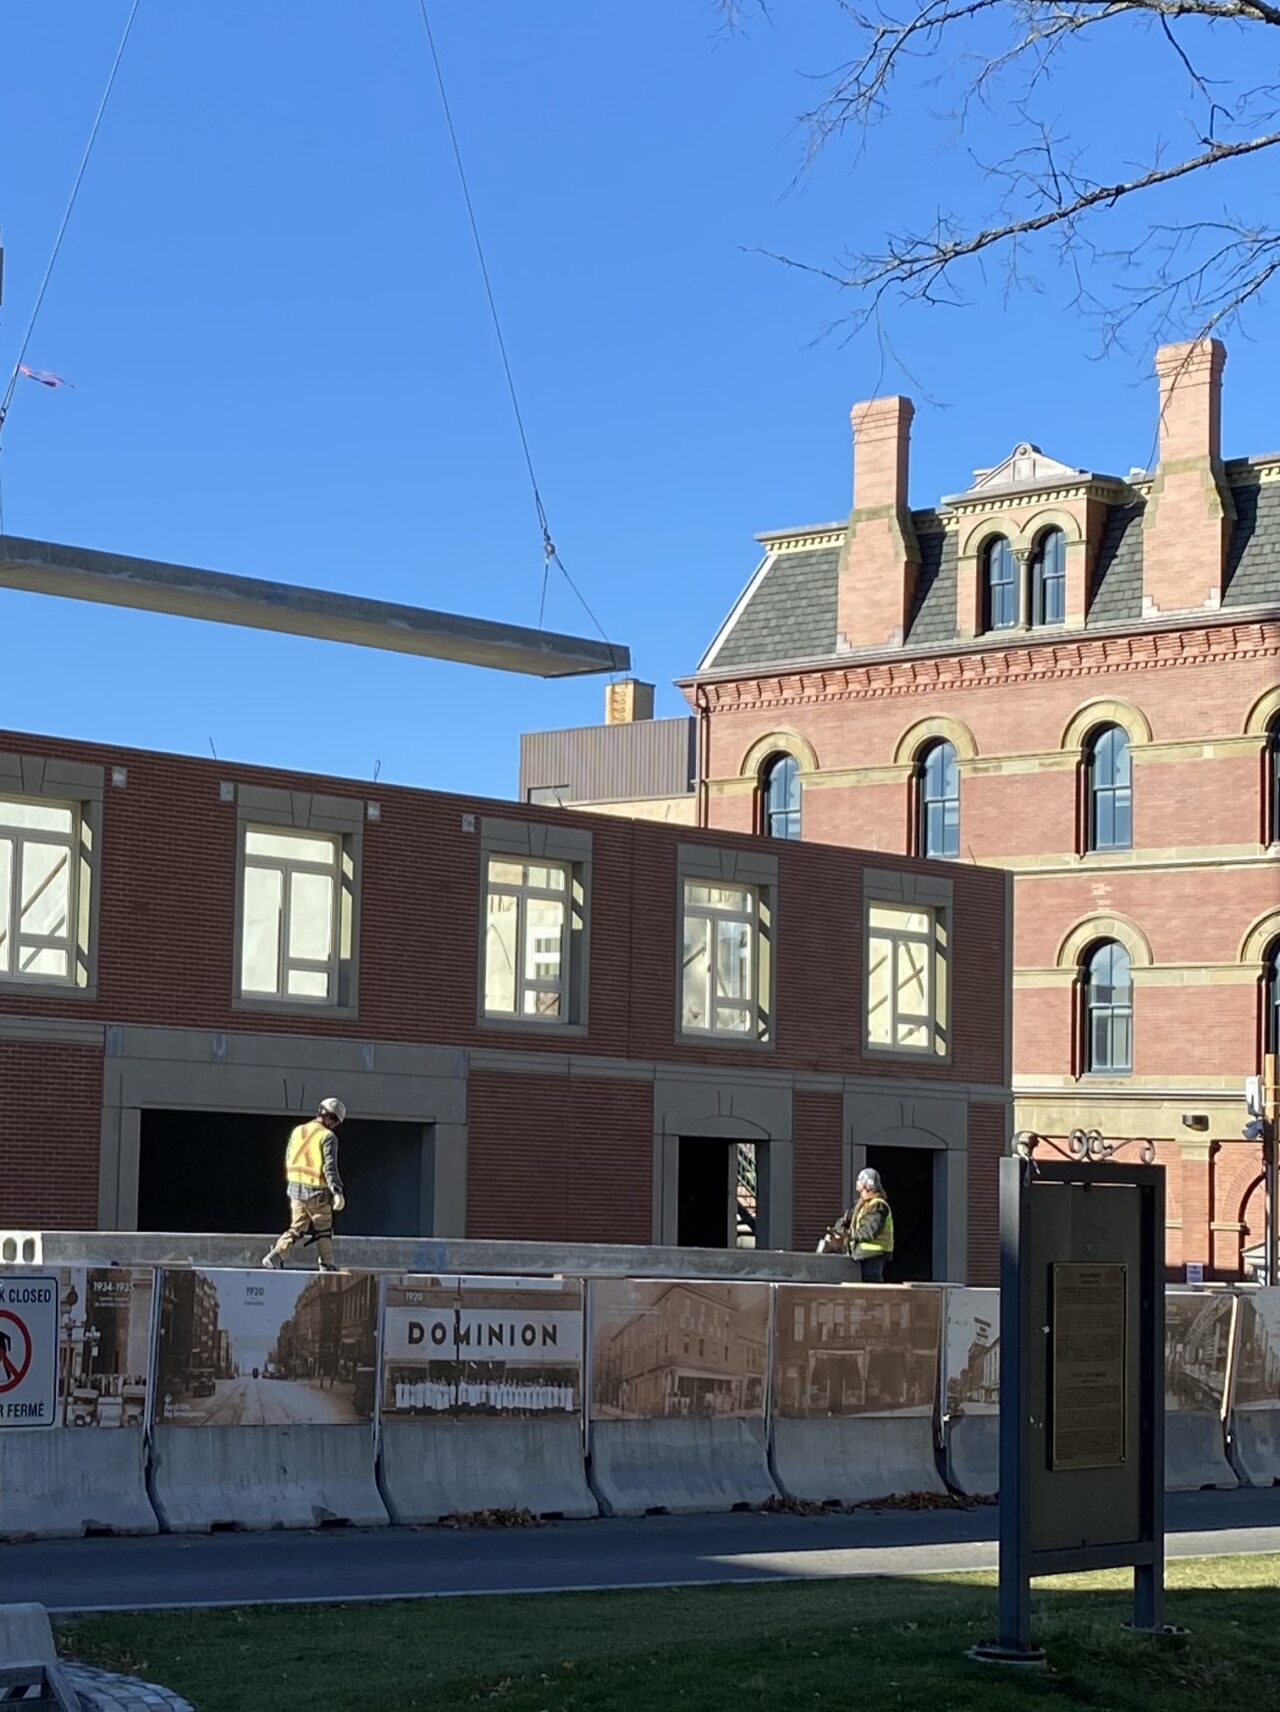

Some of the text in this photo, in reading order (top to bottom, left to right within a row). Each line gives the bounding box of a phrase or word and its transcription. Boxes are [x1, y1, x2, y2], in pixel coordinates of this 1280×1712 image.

[94, 1281, 134, 1292] 1934-1935
[246, 1287, 264, 1297] 1920
[9, 1288, 51, 1303] CLOSED
[405, 1290, 425, 1302] 1920
[408, 1321, 557, 1347] DOMINION
[7, 1400, 45, 1419] FERMÉ
